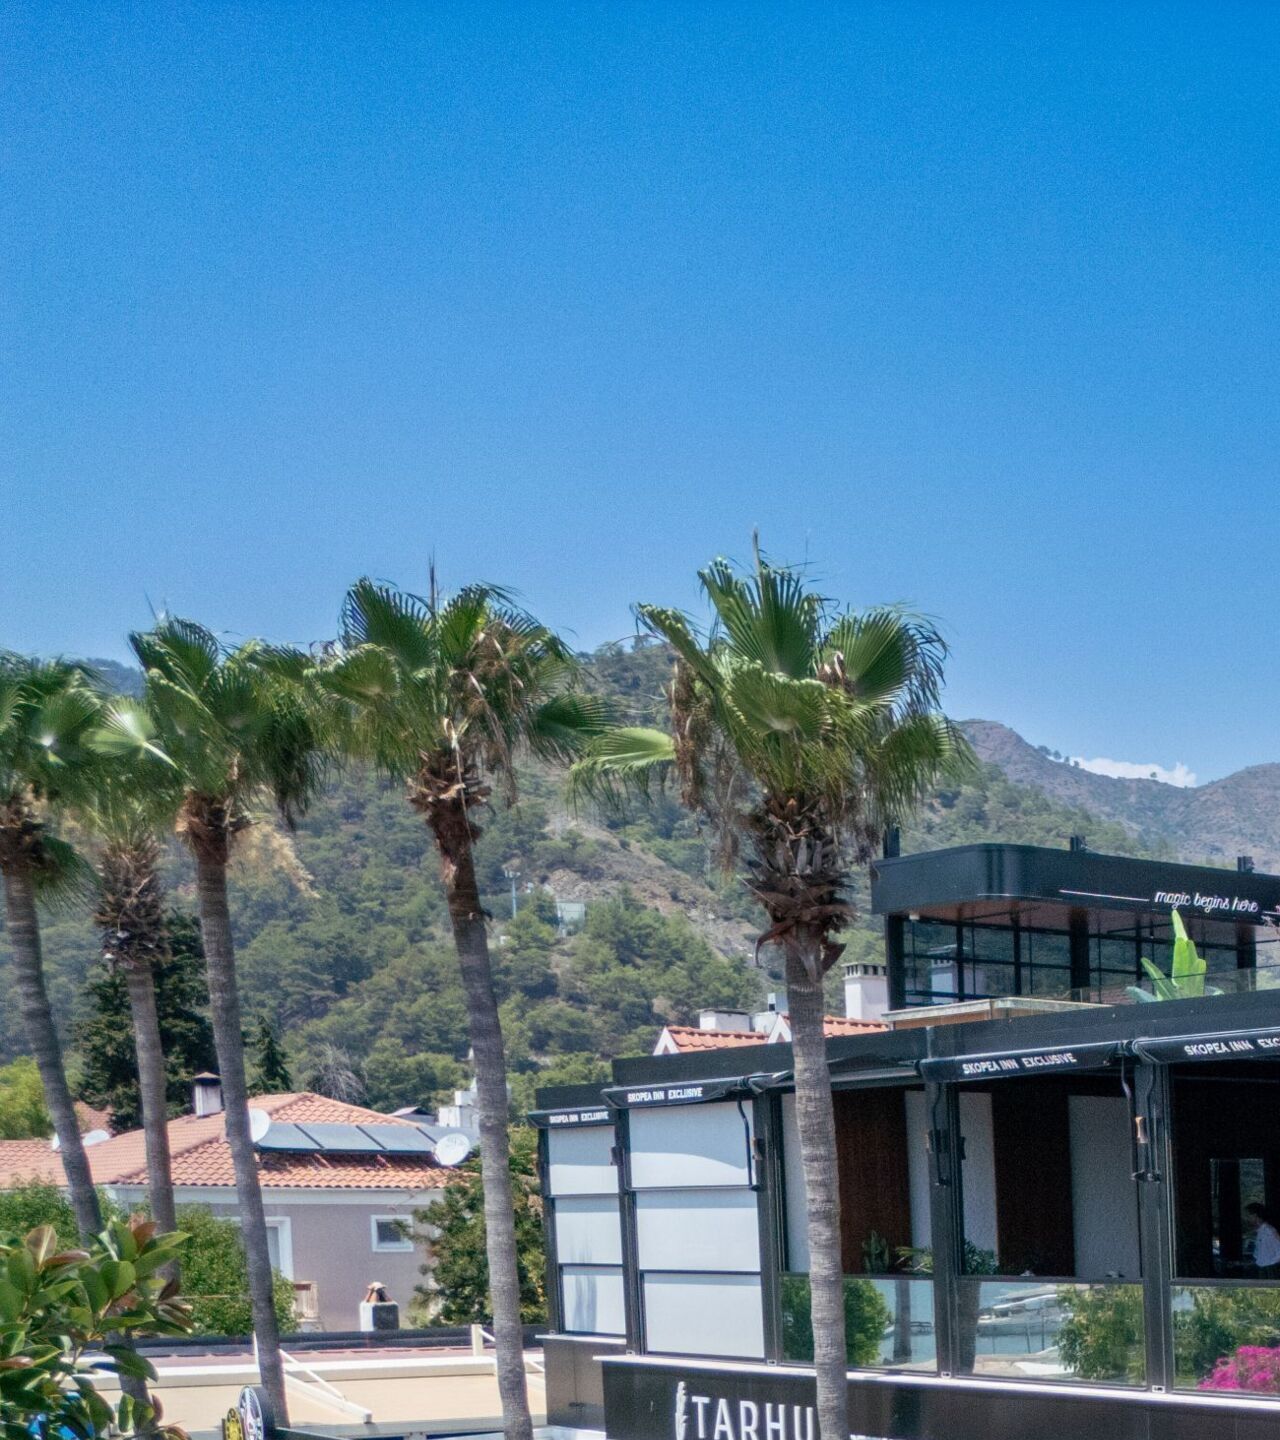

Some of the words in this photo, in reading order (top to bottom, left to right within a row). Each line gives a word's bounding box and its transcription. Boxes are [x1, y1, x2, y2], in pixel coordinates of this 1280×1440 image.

[1155, 891, 1191, 909] magic
[1193, 892, 1230, 913] begins
[1231, 897, 1259, 912] here
[1184, 1042, 1230, 1056] SKOPEA
[1229, 1040, 1255, 1052] INN
[962, 1060, 1000, 1074] SKOPEA
[999, 1059, 1020, 1070] INN
[1021, 1053, 1077, 1068] EXCLUSIVE
[627, 1091, 652, 1102] SKOPEA
[668, 1087, 703, 1100] EXCLUSIVE
